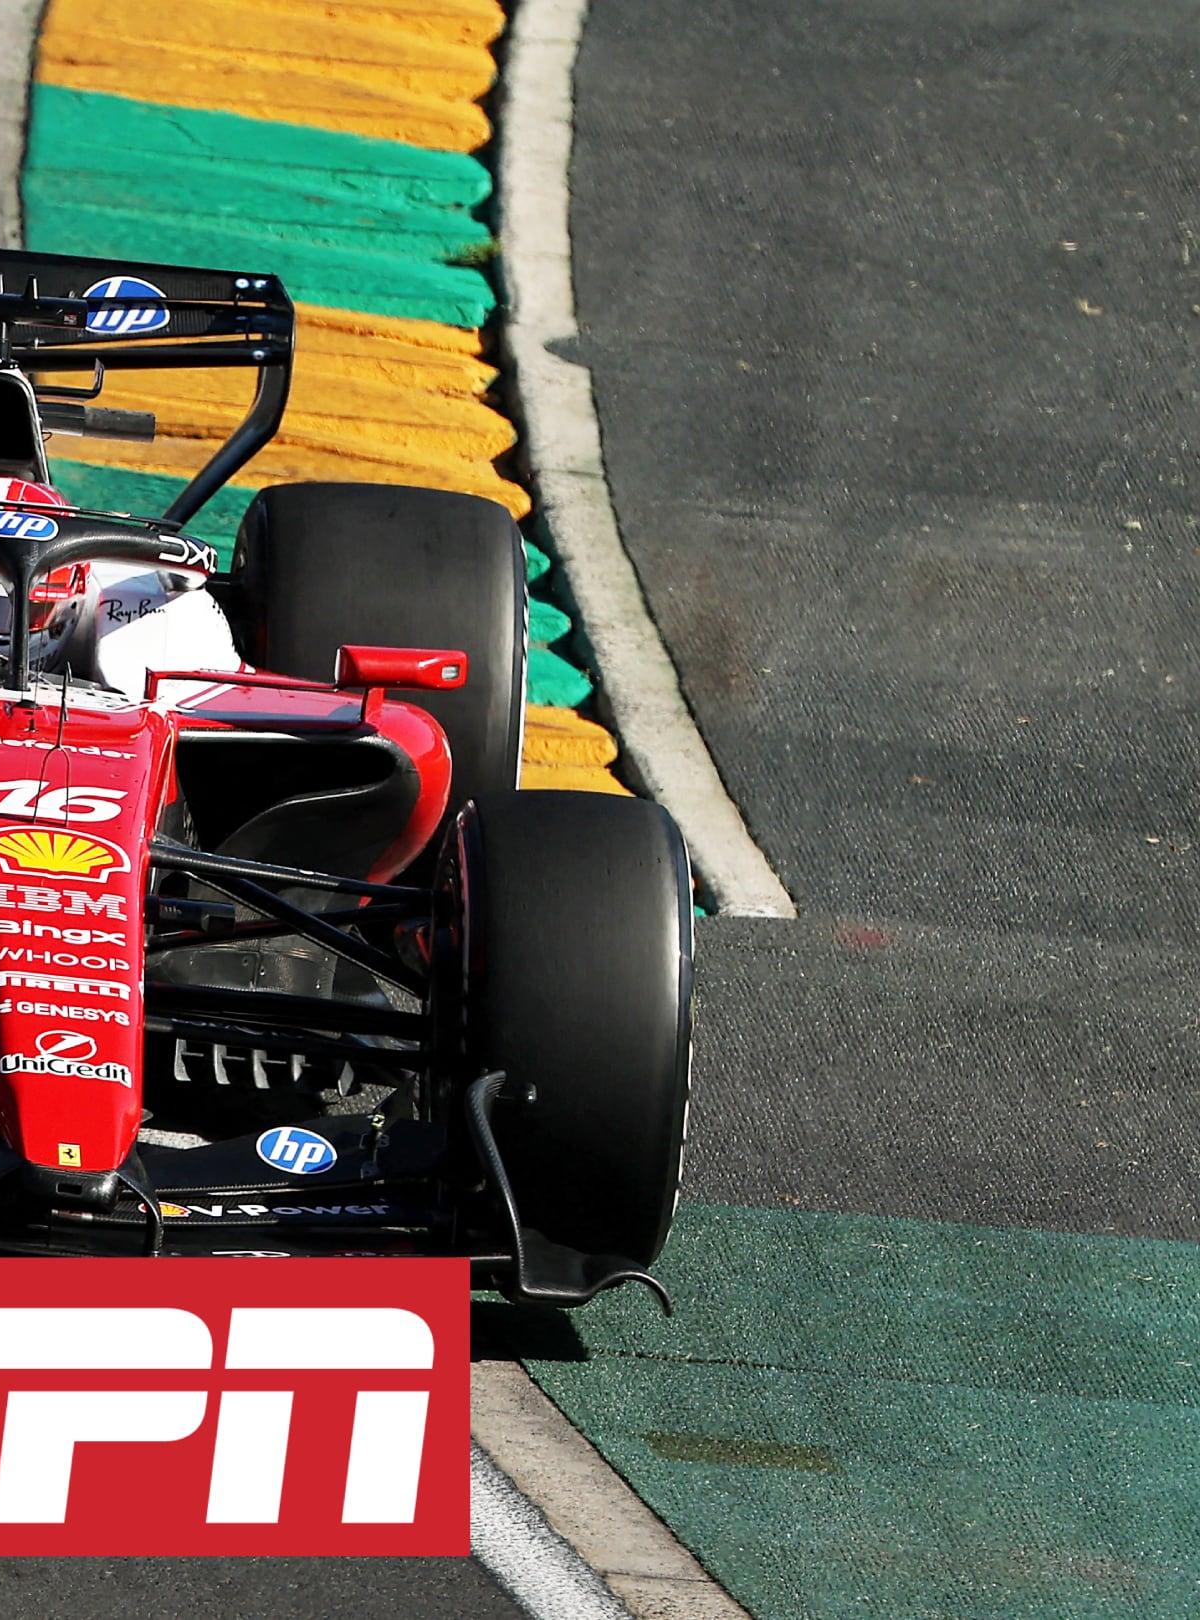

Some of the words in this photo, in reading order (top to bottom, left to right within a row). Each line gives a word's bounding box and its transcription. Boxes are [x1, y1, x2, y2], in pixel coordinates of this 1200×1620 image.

[89, 277, 158, 333] hp
[98, 598, 166, 624] Ray-Ban
[16, 1000, 131, 1027] GENESYS
[1, 1054, 131, 1087] UniCredit
[268, 1127, 328, 1174] hp
[188, 1202, 391, 1218] V-Power
